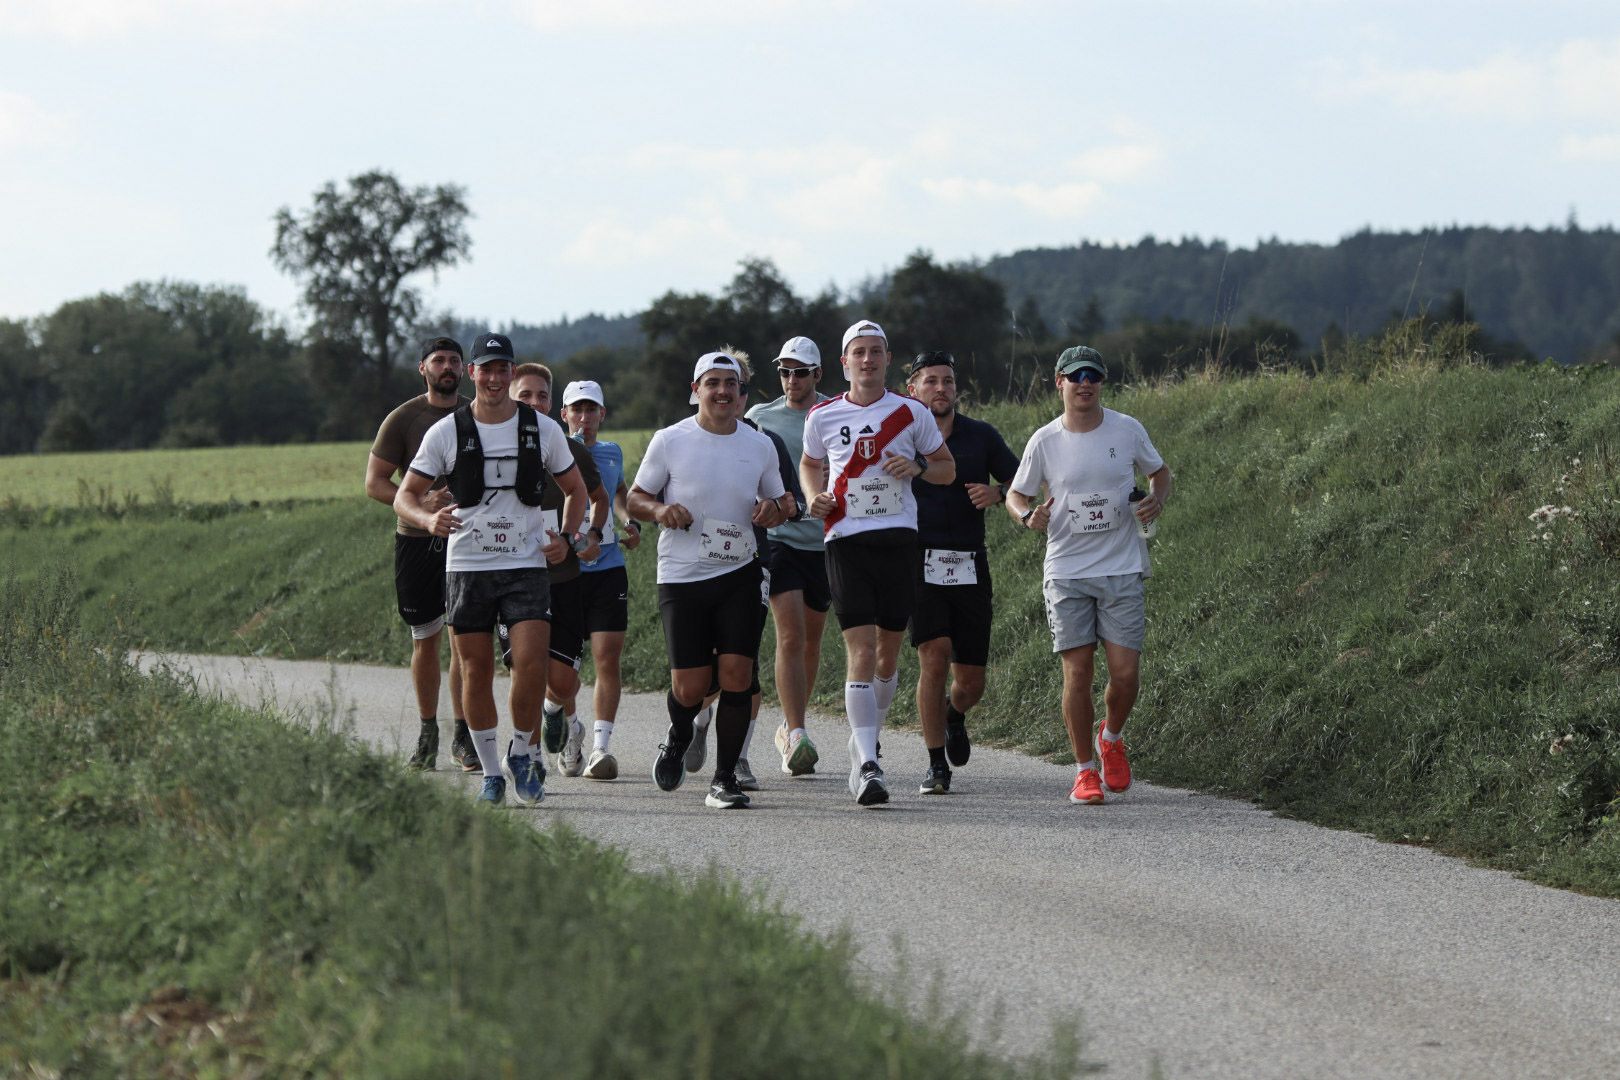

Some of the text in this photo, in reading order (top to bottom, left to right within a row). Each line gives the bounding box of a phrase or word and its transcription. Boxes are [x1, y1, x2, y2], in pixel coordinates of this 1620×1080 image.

[840, 425, 851, 446] 9
[872, 495, 880, 505] 2
[1089, 510, 1104, 521] 34
[1083, 522, 1111, 531] VINCENT
[494, 533, 507, 543] 10
[723, 540, 732, 551] 8
[708, 551, 740, 561] BENJAMIN
[946, 567, 955, 576] 11
